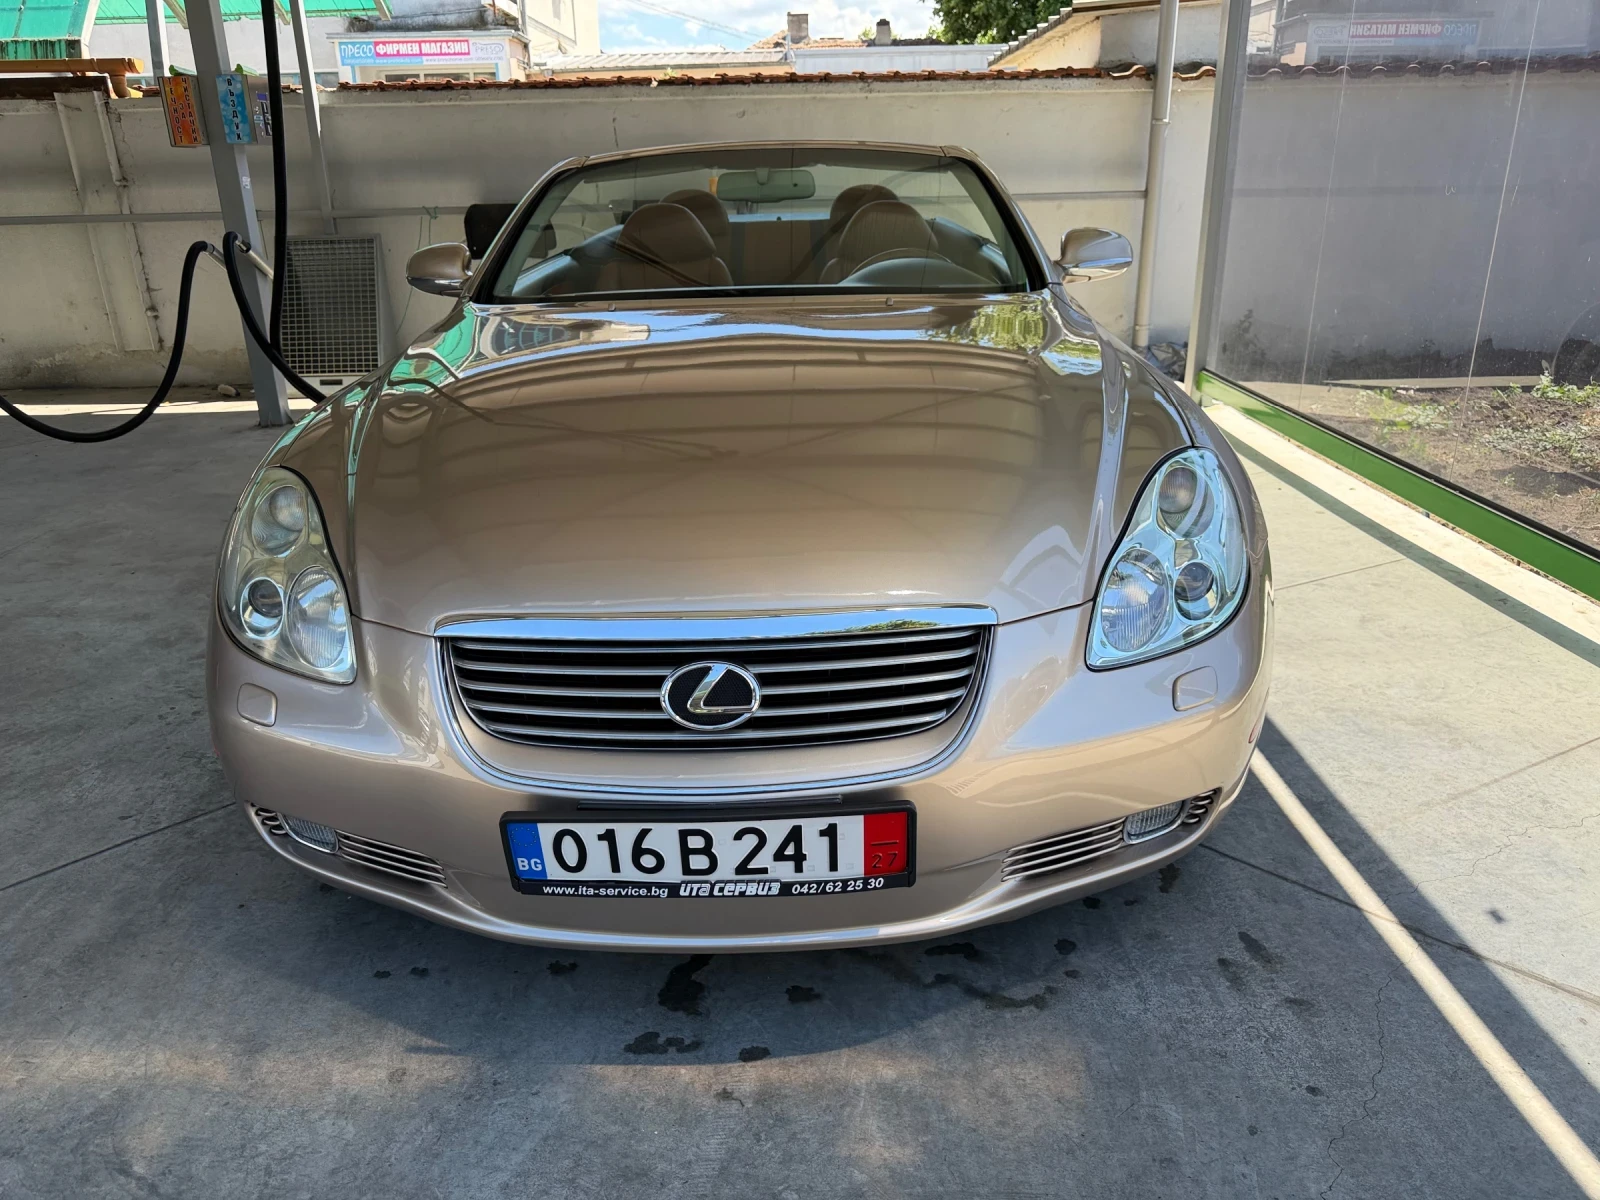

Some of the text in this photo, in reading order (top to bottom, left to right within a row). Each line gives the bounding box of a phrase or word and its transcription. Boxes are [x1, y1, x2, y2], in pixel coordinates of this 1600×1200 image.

[340, 41, 468, 58] ПРЕСО ФИРМЕН МАГАЗИН
[168, 77, 184, 143] ТЕЧНОСТ
[178, 102, 187, 119] ЗА
[181, 77, 198, 143] ЧИСТАЧКИ
[227, 78, 242, 141] ВЪЗДУХ
[517, 858, 543, 871] BG
[871, 851, 899, 869] 27
[543, 885, 669, 898] www.ita-service.bg
[791, 877, 884, 895] 042/62 25 30
